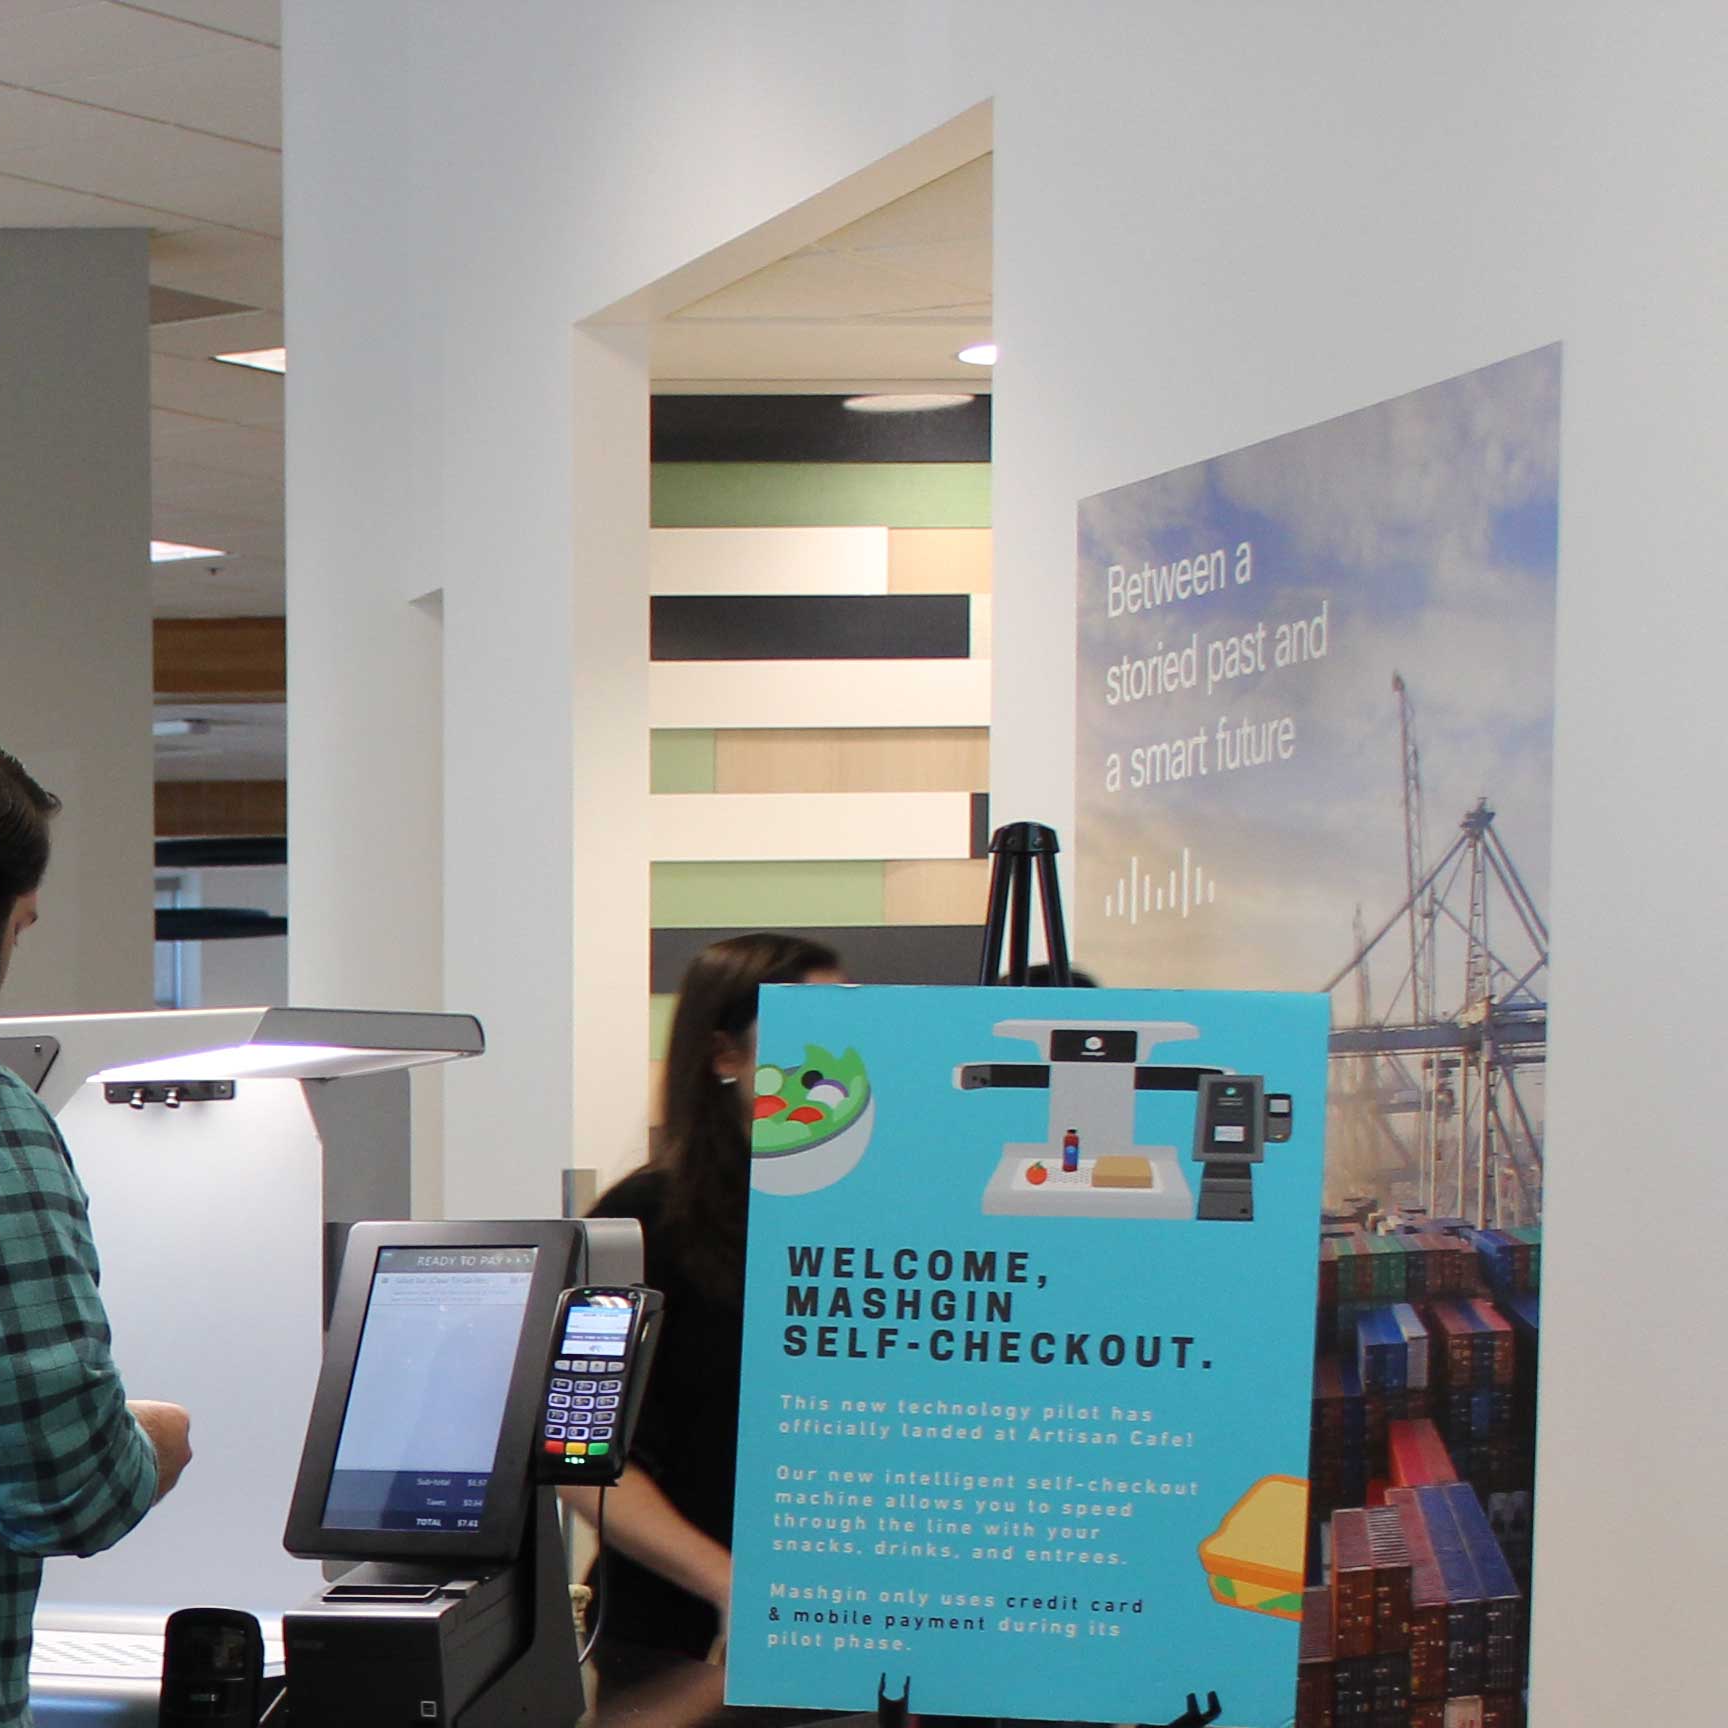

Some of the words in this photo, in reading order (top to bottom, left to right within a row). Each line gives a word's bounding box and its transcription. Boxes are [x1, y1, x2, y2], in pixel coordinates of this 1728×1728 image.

[1108, 548, 1226, 618] Between
[1234, 541, 1252, 584] a
[1106, 633, 1198, 705] storied
[1207, 622, 1267, 696] past
[1274, 600, 1329, 668] and
[1106, 752, 1121, 793] a
[1130, 726, 1208, 788] smart
[1215, 716, 1296, 771] future
[416, 1255, 457, 1267] READY
[460, 1255, 476, 1266] TO
[480, 1255, 504, 1266] PAY
[787, 1246, 1048, 1289] WELCOME,
[785, 1285, 1013, 1323] MASHGIN
[783, 1325, 1213, 1370] SELF-CHECKOUT.
[780, 1395, 830, 1411] This
[842, 1400, 887, 1414] new
[897, 1399, 1032, 1421] technology
[1043, 1404, 1100, 1421] pilot
[1111, 1406, 1153, 1422] has
[778, 1418, 891, 1440] officially
[901, 1423, 984, 1440] landed
[995, 1427, 1016, 1441] at
[1027, 1427, 1120, 1445] Artisan
[1130, 1430, 1195, 1448] Cafe!
[776, 1465, 817, 1481] Our
[828, 1470, 874, 1483] new
[885, 1469, 1017, 1490] intelligent
[1026, 1475, 1199, 1496] self-checkout
[775, 1491, 874, 1507] machine
[885, 1494, 964, 1511] allows
[975, 1499, 1017, 1514] you
[1028, 1500, 1051, 1514] to
[1061, 1502, 1134, 1518] speed
[416, 1518, 442, 1527] TOTAL
[773, 1513, 867, 1533] through
[878, 1517, 916, 1533] the
[927, 1519, 973, 1535] line
[984, 1522, 1036, 1537] with
[1046, 1527, 1101, 1541] your
[971, 1545, 1015, 1560] and
[1025, 1549, 1128, 1565] entrees.
[770, 1583, 868, 1604] Mashgin
[879, 1589, 930, 1607] only
[940, 1594, 995, 1608] uses
[1006, 1596, 1078, 1611] credit
[1090, 1599, 1143, 1614] card
[768, 1606, 780, 1622] &
[794, 1609, 873, 1625] mobile
[885, 1615, 986, 1631] payment
[998, 1617, 1079, 1638] during
[1089, 1622, 1121, 1637] its
[767, 1631, 823, 1648] pilot
[833, 1634, 912, 1651] phase.
